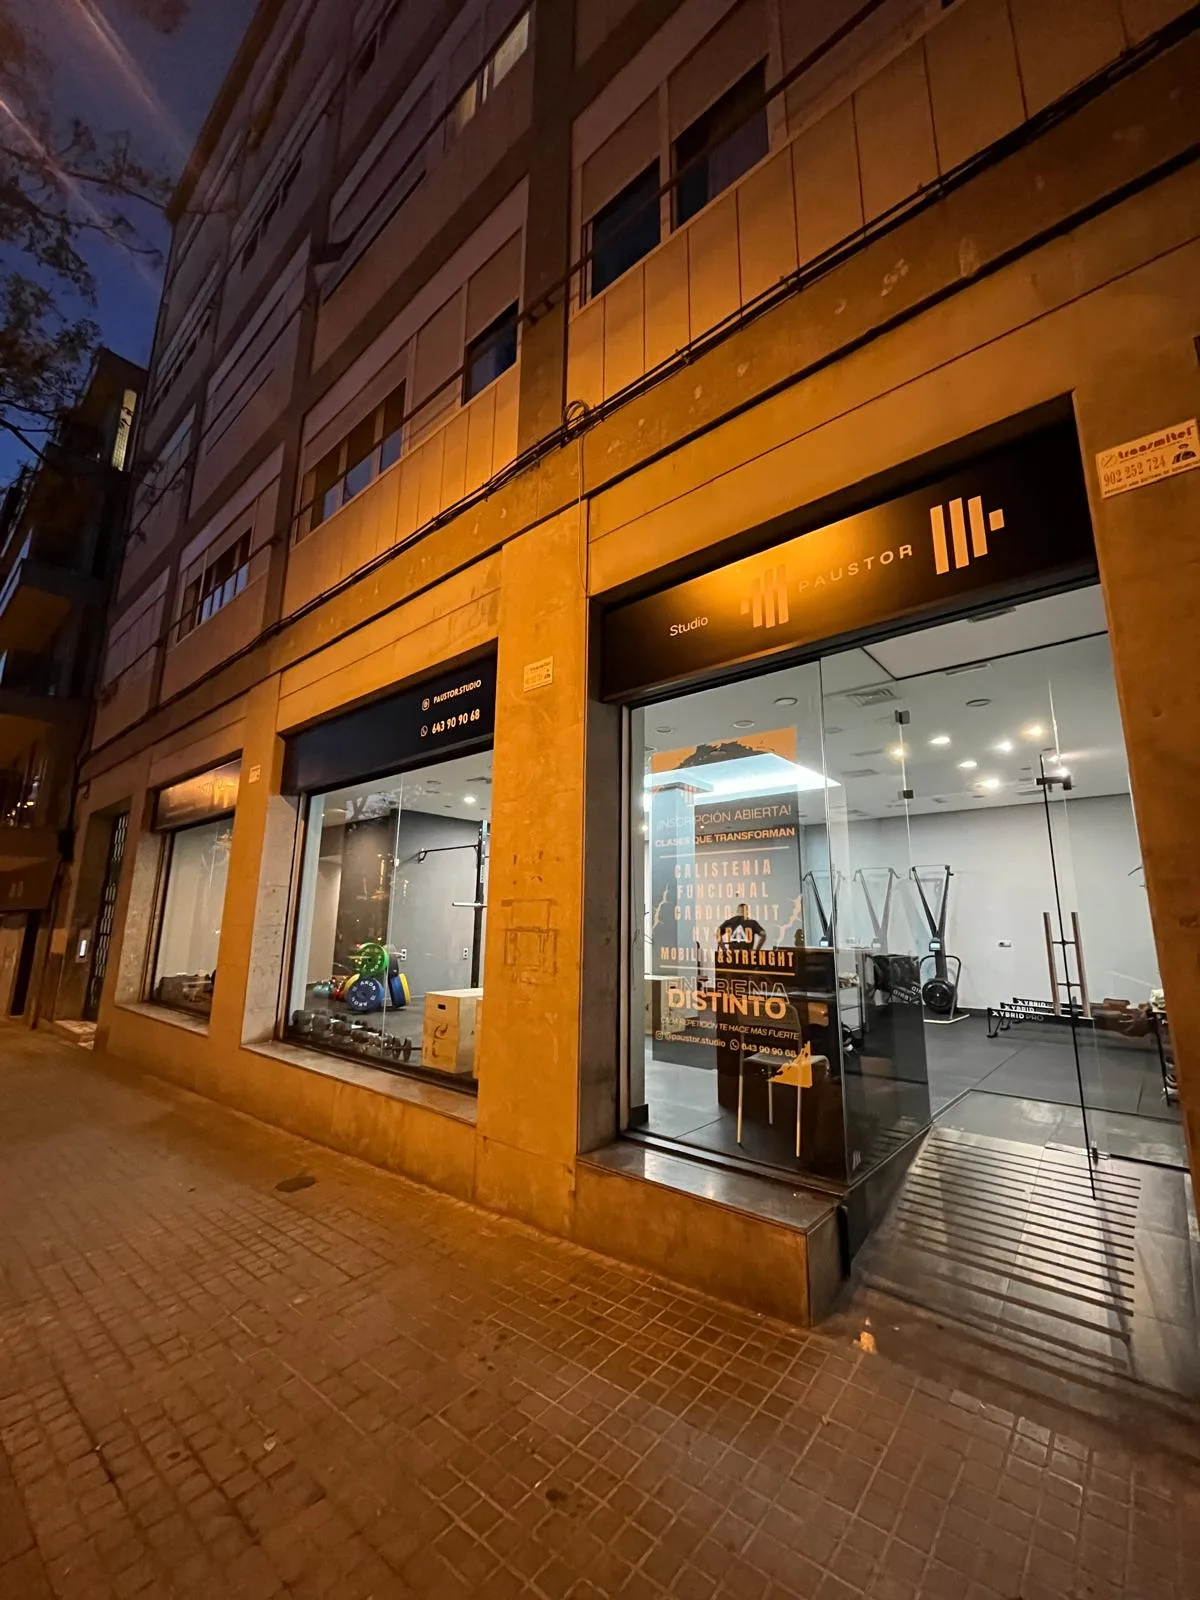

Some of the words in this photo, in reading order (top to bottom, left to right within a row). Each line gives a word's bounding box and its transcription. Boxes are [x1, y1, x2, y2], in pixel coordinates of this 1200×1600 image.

[1104, 469, 1122, 487] 902
[1126, 462, 1143, 479] 252
[1146, 455, 1166, 472] 724
[797, 544, 913, 593] PAUSTOR
[669, 615, 709, 637] Studio
[431, 720, 445, 734] 643
[446, 717, 457, 729] 90
[458, 712, 468, 725] 90
[470, 708, 480, 721] 68
[734, 804, 792, 821] ABIERTA!
[655, 836, 690, 848] CLASES
[694, 833, 713, 845] QUE
[714, 827, 796, 843] TRANSFORMAN
[674, 859, 772, 879] CALISTENIA
[677, 882, 769, 899] FUNCIONAL
[665, 976, 790, 1004] ENTRENA
[667, 988, 787, 1020] DISTINTO
[992, 1010, 1025, 1020] XYBRID
[719, 1023, 728, 1031] TE
[729, 1025, 750, 1034] HACE
[768, 1029, 800, 1040] FUERTE
[741, 1042, 757, 1052] 643
[759, 1046, 770, 1054] 90
[772, 1048, 783, 1056] 90
